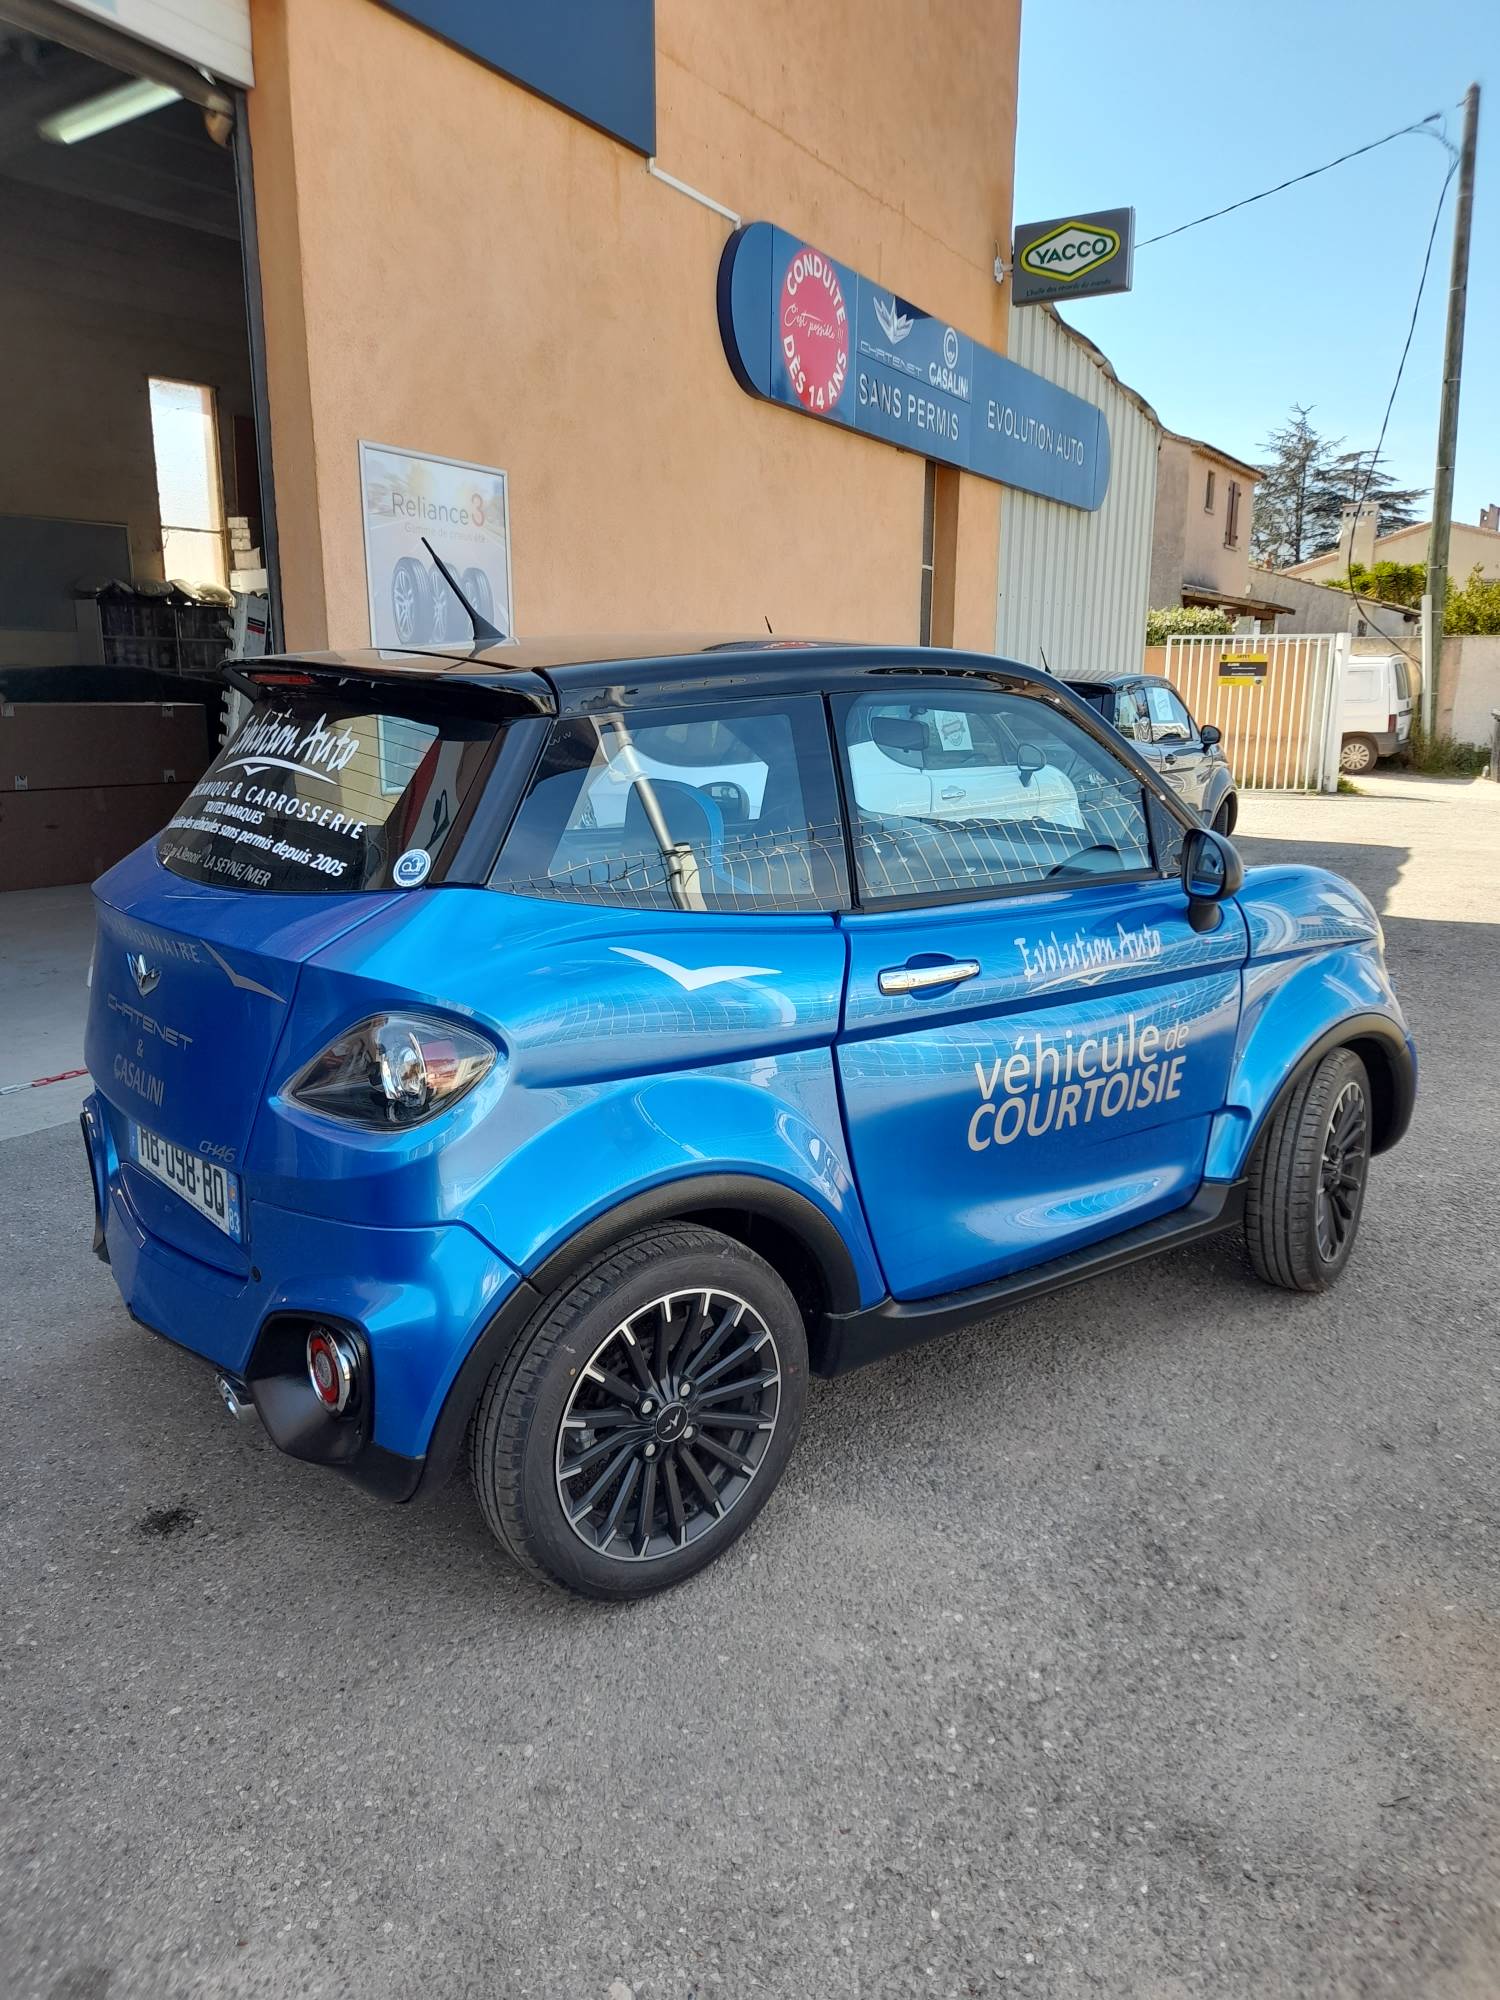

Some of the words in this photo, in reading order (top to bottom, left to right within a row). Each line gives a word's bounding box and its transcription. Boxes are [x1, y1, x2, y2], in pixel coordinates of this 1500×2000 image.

[1035, 238, 1107, 265] YACCO
[787, 254, 846, 325] CONDUITE
[809, 385, 824, 409] 14
[828, 350, 847, 405] ANS
[860, 340, 922, 377] CHATENET
[859, 373, 902, 418] SANS
[907, 394, 959, 440] PERMIS
[987, 399, 1054, 454] EVOLUTION
[1056, 432, 1084, 466] AUTO
[297, 713, 360, 772] Auto
[203, 800, 226, 814] TOUTES
[222, 801, 266, 825] MARQUES
[231, 782, 243, 798] &
[245, 786, 367, 840] CARROSSERIE
[203, 854, 217, 870] LA
[214, 858, 272, 887] SEYNE/MER
[218, 824, 241, 840] sans
[234, 829, 275, 851] permis
[271, 839, 313, 865] depuis
[309, 853, 348, 877] 2005
[1014, 927, 1117, 982] Evolution
[1118, 922, 1162, 961] Auto
[107, 992, 193, 1052] CHATENET
[136, 1039, 144, 1058] &
[114, 1053, 165, 1107] CASALINI
[975, 1014, 1160, 1100] véhicule
[1165, 1019, 1190, 1052] de
[967, 1056, 1187, 1151] COURTOISIE
[199, 1140, 237, 1163] CH46
[228, 1207, 240, 1235] 83
